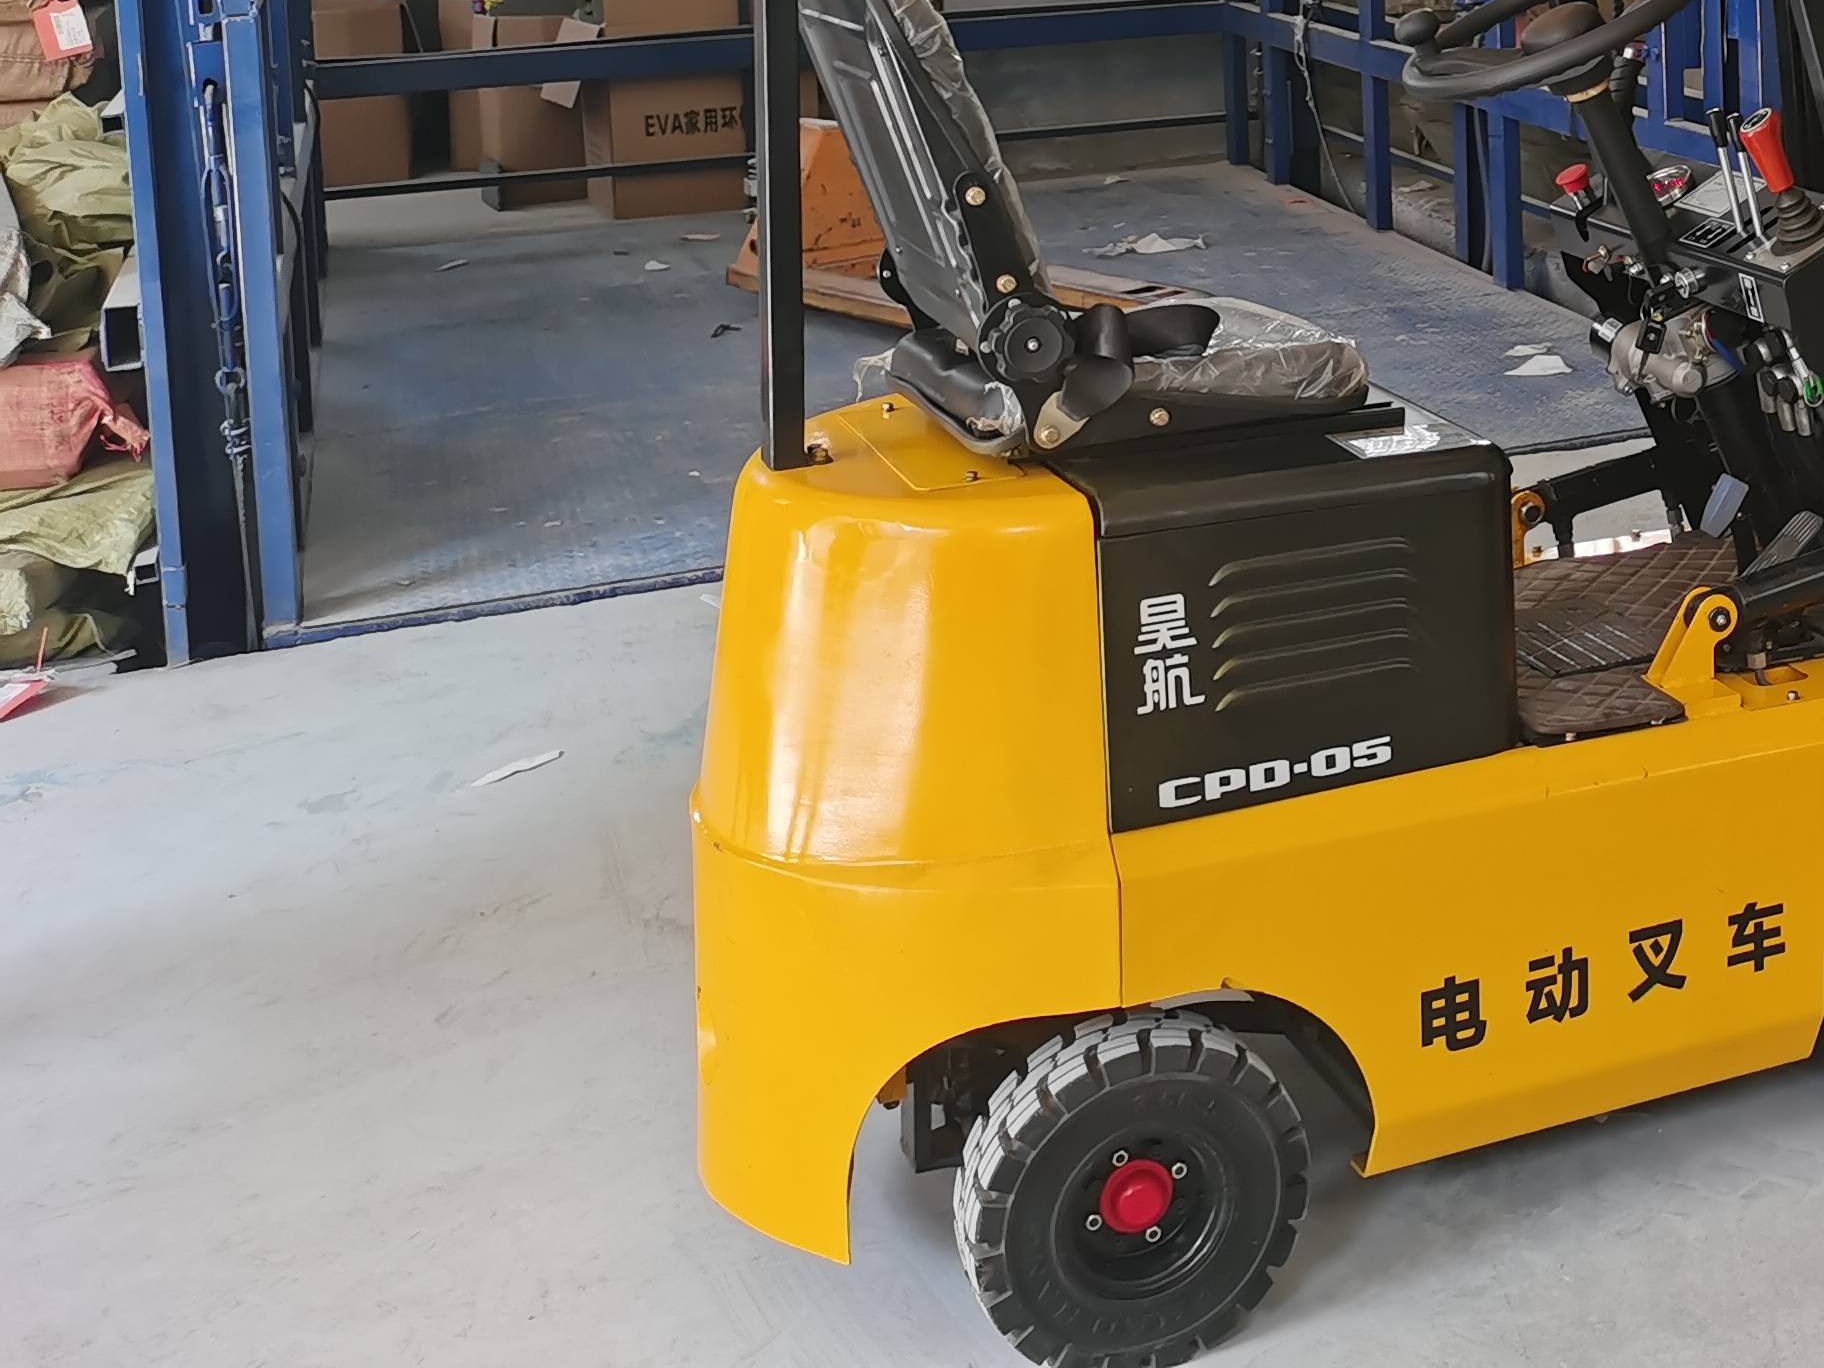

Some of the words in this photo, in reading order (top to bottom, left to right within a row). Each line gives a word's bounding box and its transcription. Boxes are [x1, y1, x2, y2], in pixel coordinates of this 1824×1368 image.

[644, 106, 745, 137] EVA家用环
[1134, 593, 1206, 714] 昊航
[1158, 736, 1392, 808] CPD-05
[1420, 902, 1786, 1052] 电动叉车
